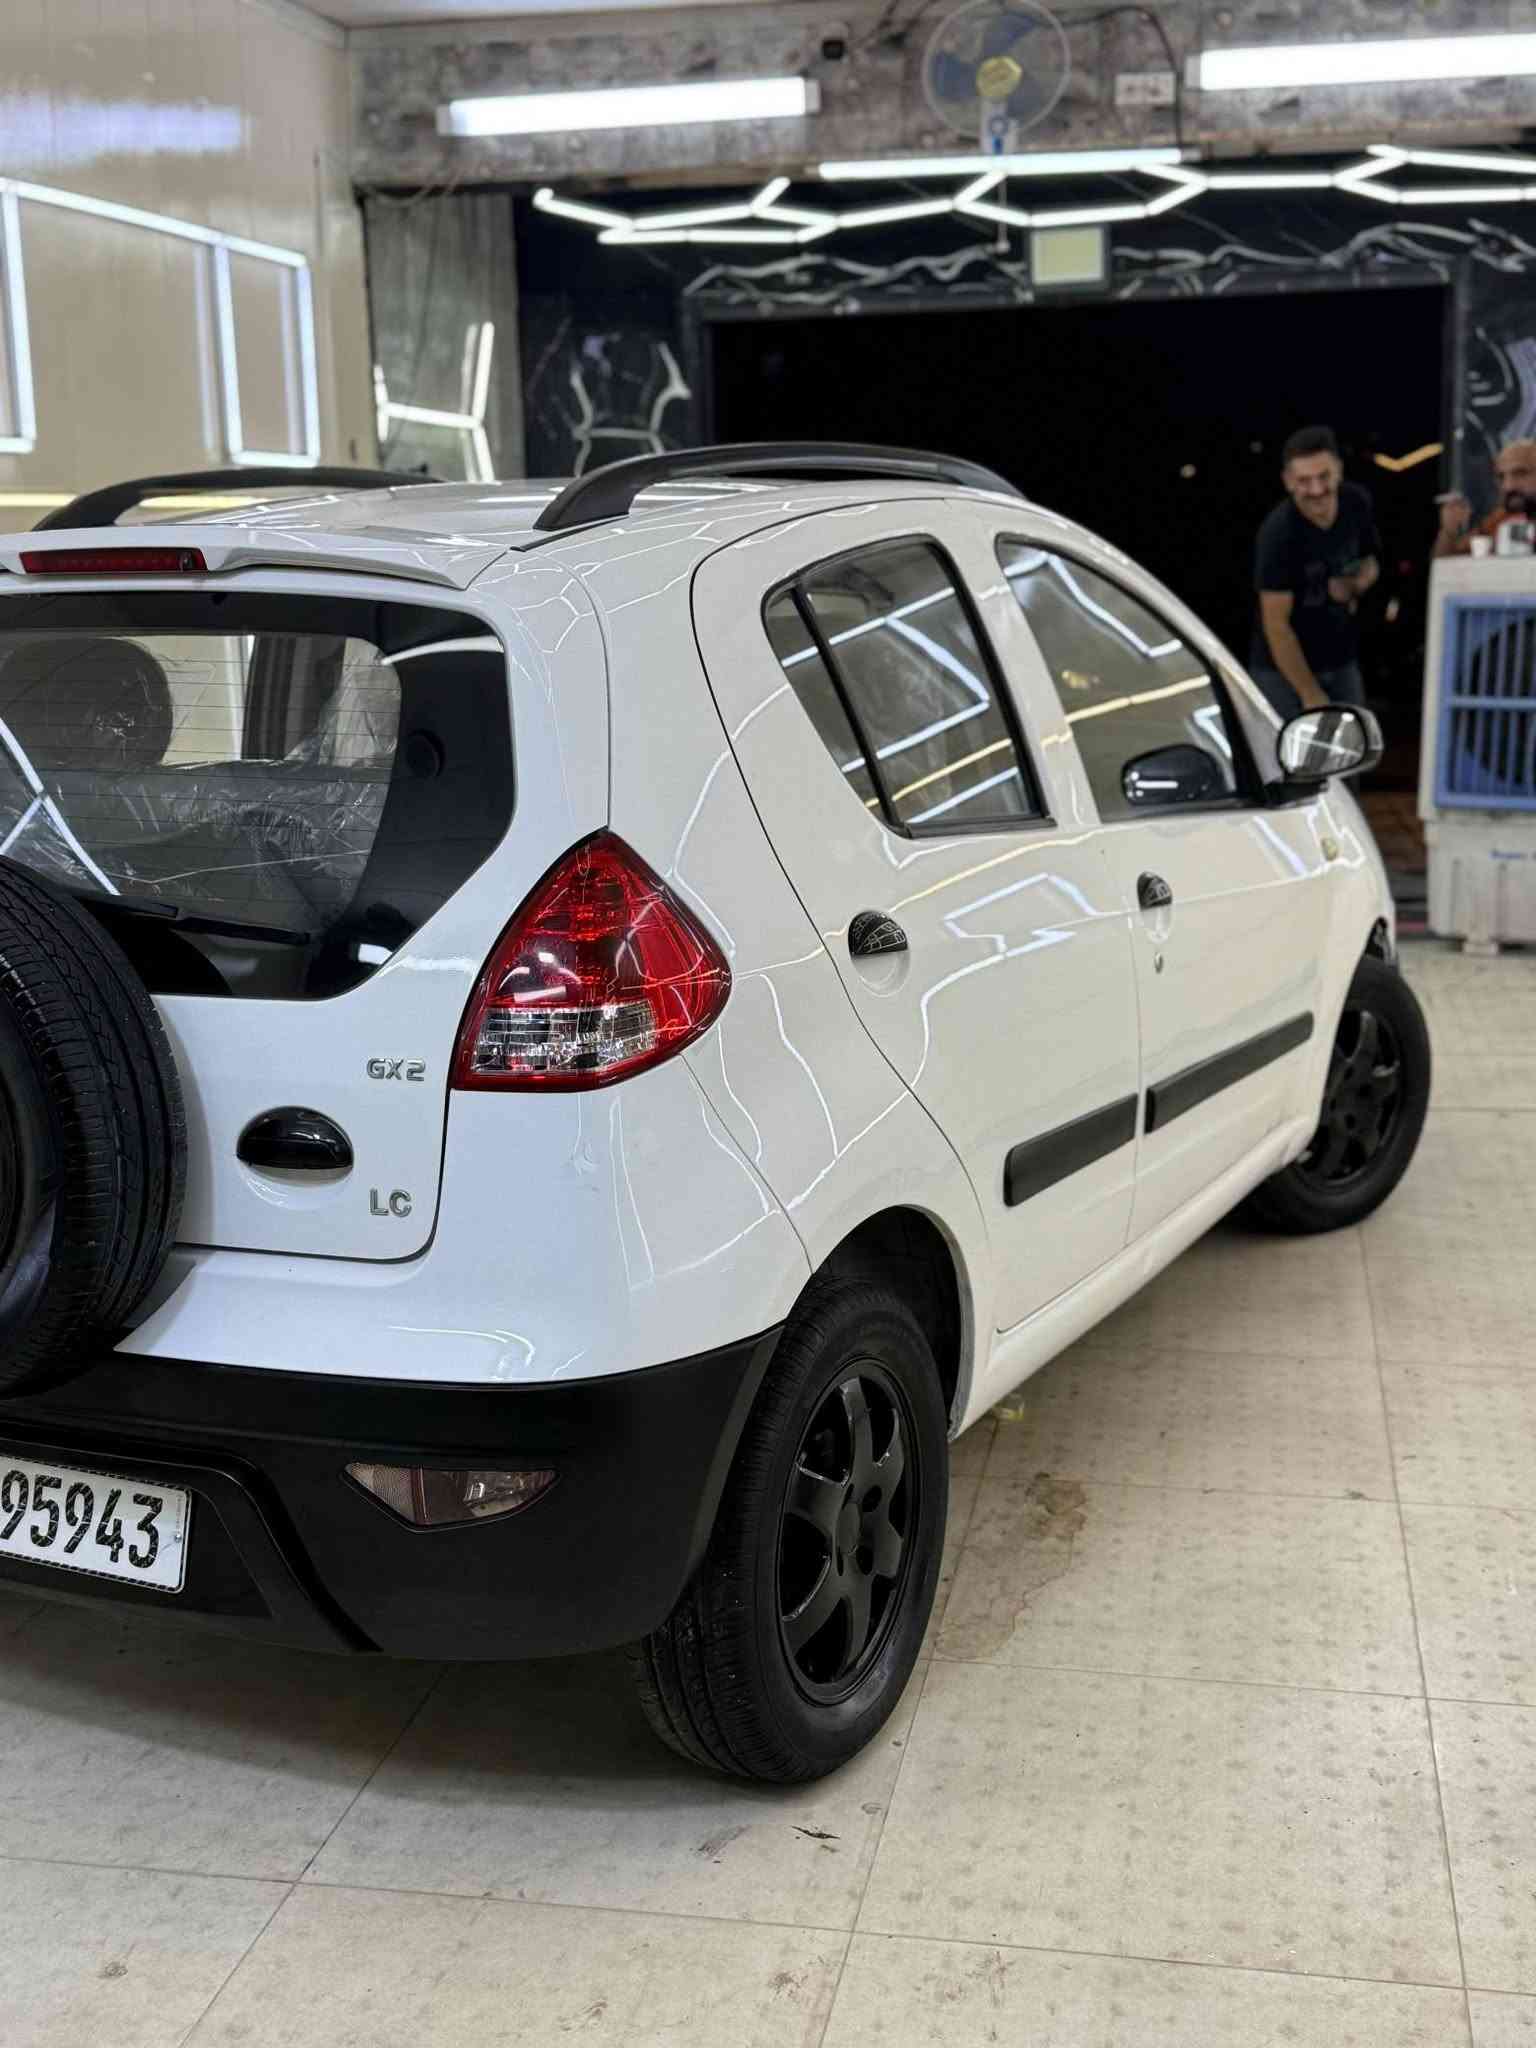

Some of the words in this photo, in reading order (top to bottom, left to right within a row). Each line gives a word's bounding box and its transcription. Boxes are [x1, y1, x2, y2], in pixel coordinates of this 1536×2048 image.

[366, 1057, 426, 1082] GX2
[369, 1187, 413, 1218] LC
[0, 1469, 163, 1569] 95943
